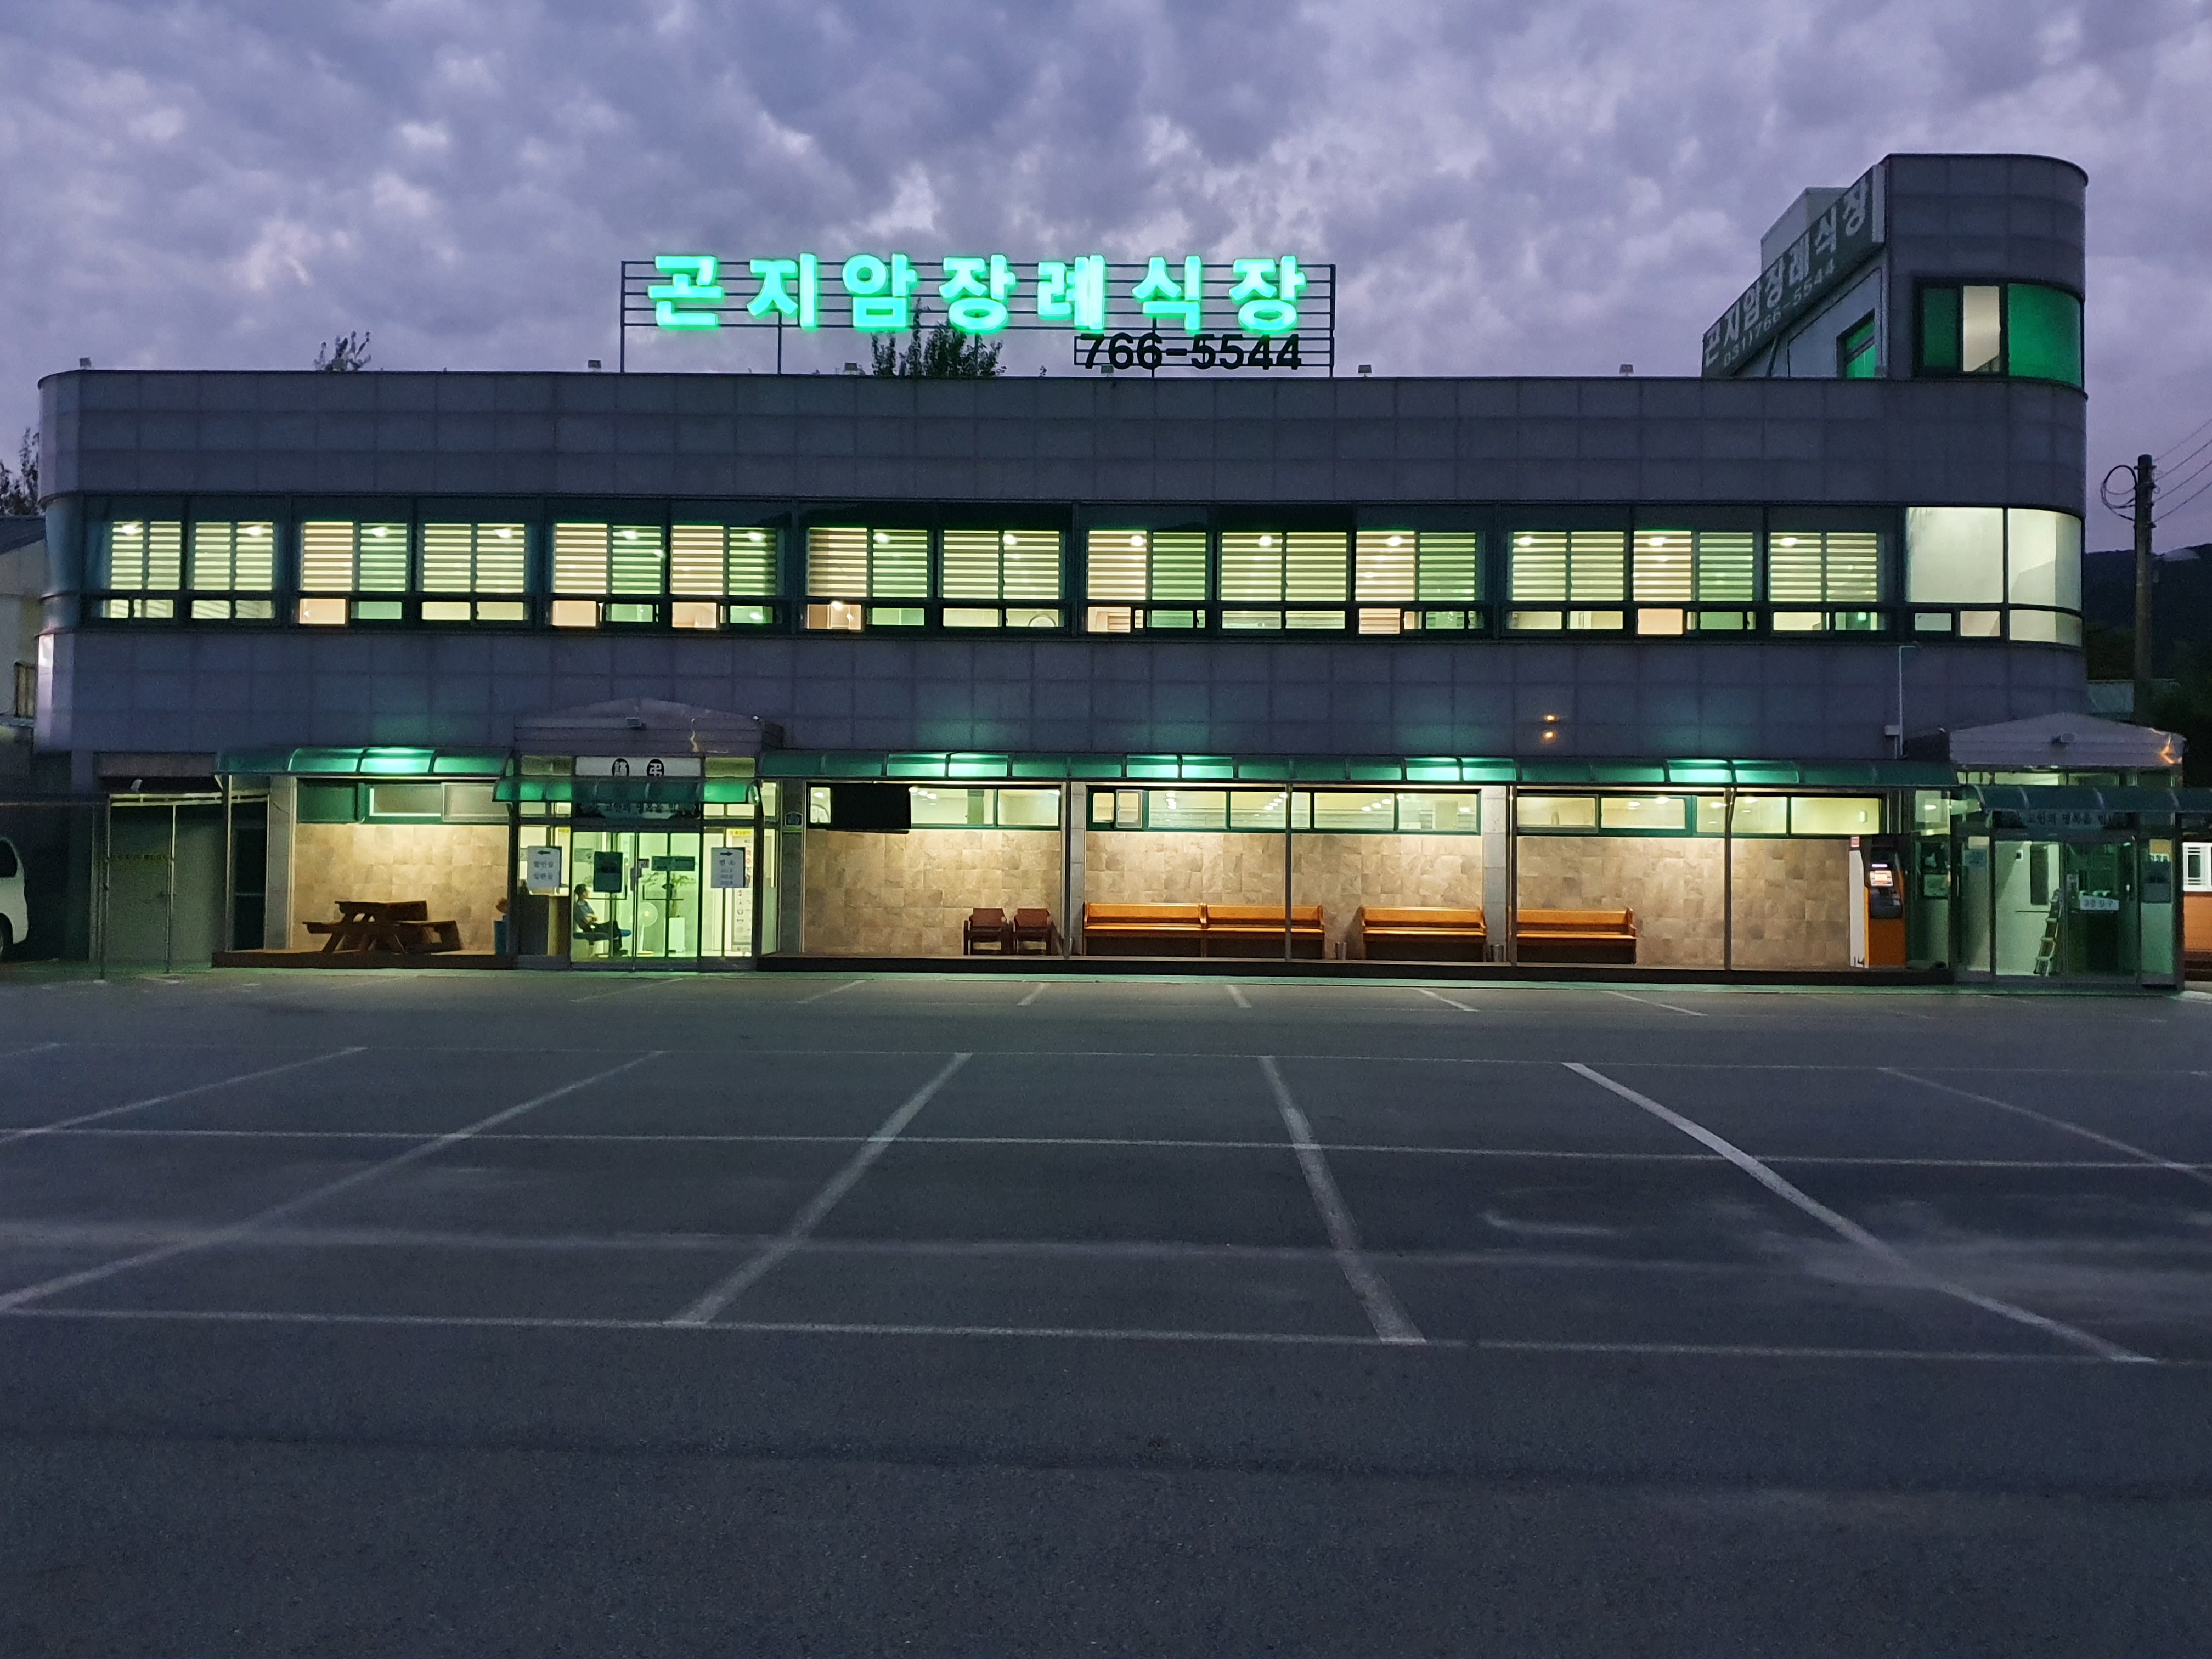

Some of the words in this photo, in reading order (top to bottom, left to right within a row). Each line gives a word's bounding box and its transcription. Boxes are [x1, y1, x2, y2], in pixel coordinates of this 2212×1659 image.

[647, 252, 1307, 332] 곤지암장례식장
[1705, 177, 1870, 368] 곤지암장례식장
[1081, 331, 1304, 370] 766-5544
